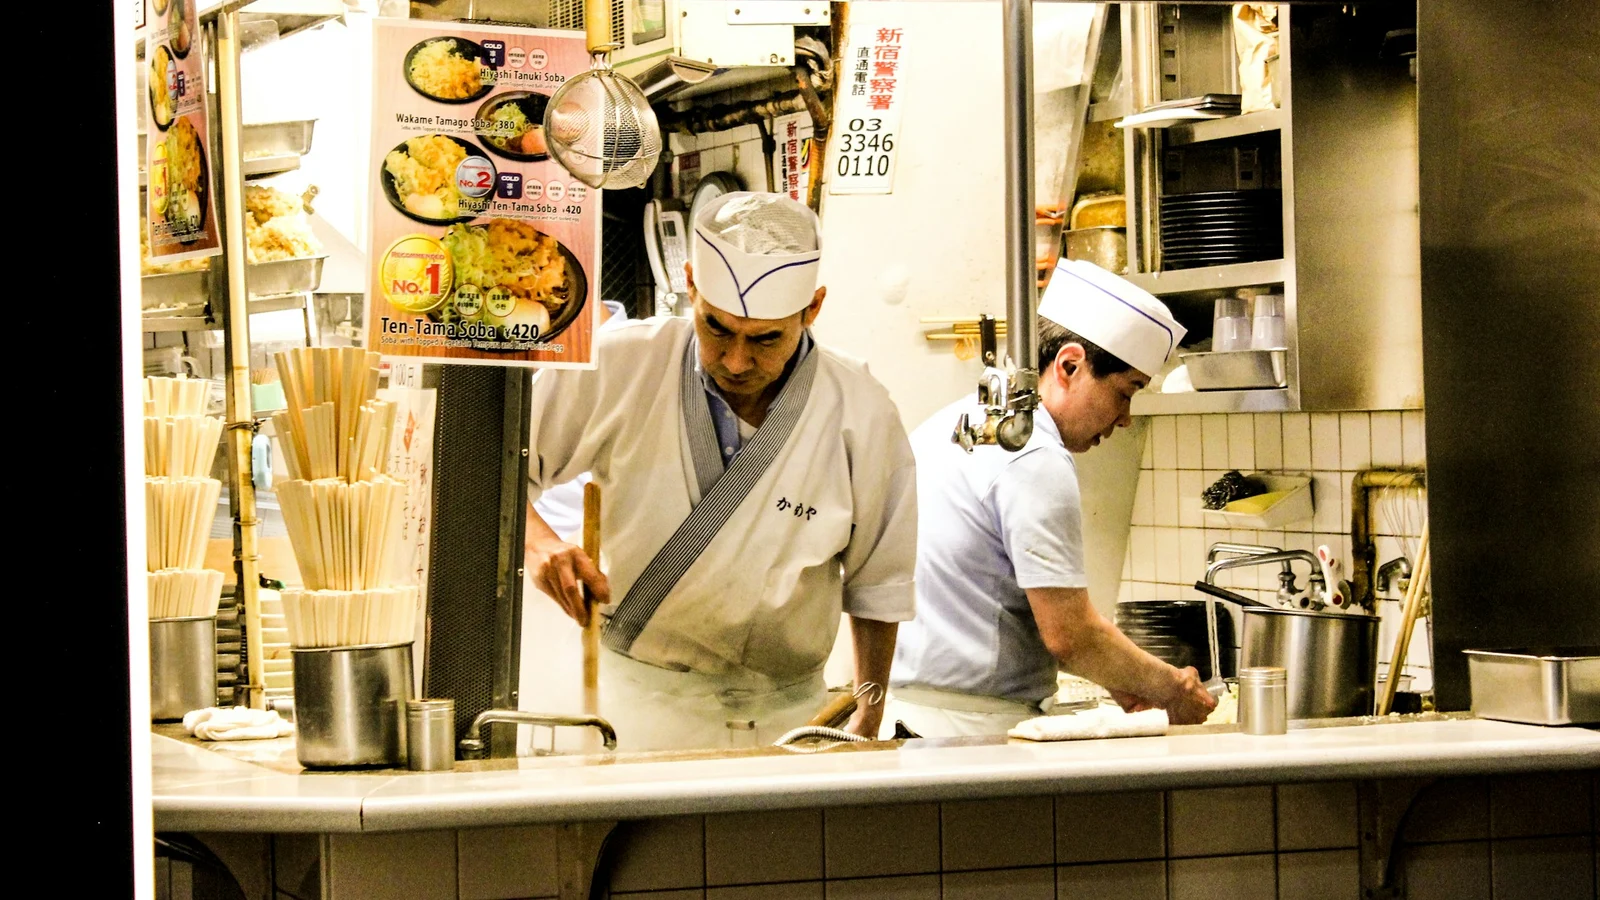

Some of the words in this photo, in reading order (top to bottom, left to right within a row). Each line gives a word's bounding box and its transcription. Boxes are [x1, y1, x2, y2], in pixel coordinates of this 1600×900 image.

[480, 69, 512, 79] Hiyashi
[514, 70, 542, 81] Tanuki
[544, 72, 565, 82] Soba
[851, 46, 871, 96] 直通電話
[866, 27, 904, 110] 新宿警察署
[395, 113, 433, 124] Wakame
[435, 115, 468, 128] Tamago
[470, 118, 491, 128] Soba
[848, 118, 882, 132] 03
[840, 133, 894, 152] 3346
[837, 154, 890, 176] 0110
[460, 171, 491, 188] No.2
[458, 199, 490, 211] Hiyashi
[493, 201, 535, 212] Ten-Tama
[536, 203, 557, 213] Soba
[392, 264, 441, 295] No.1
[381, 317, 455, 337] Ten-Tama
[460, 320, 496, 338] Soba
[504, 323, 539, 339] ¥420
[776, 496, 817, 521] かめや
